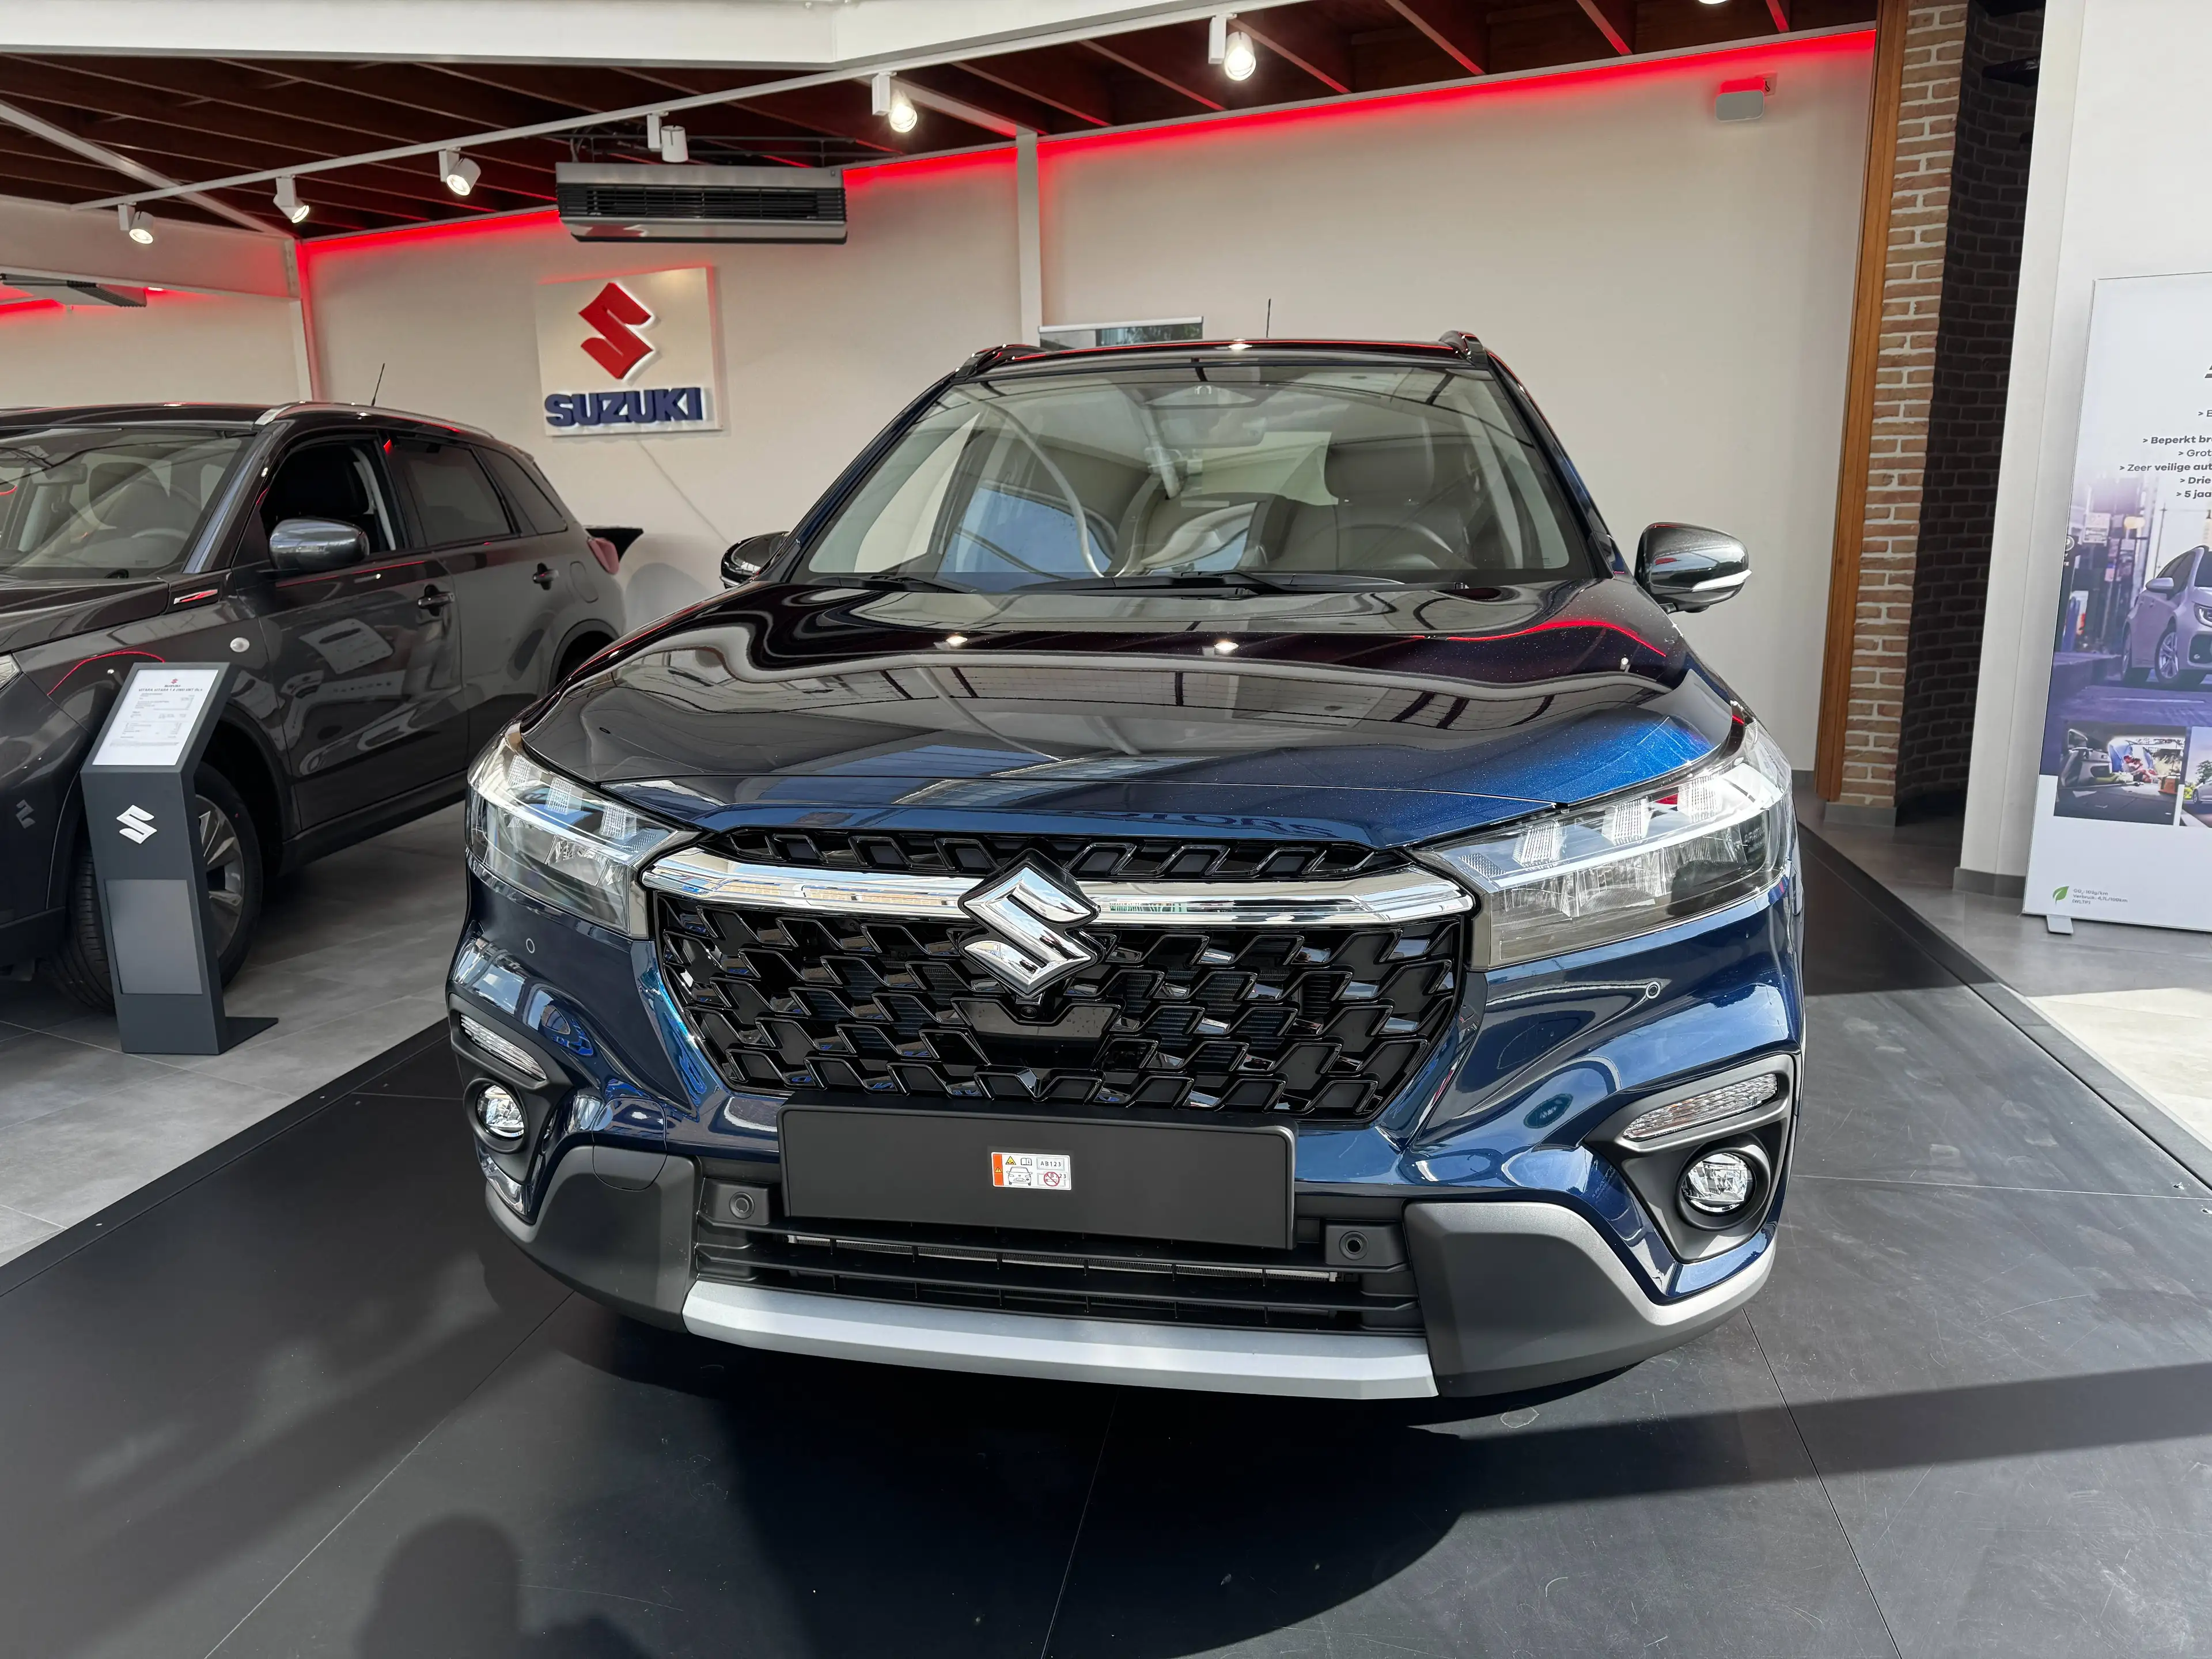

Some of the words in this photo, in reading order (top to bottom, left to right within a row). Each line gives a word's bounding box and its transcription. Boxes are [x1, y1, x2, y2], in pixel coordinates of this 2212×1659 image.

[545, 388, 703, 427] SUZUKI
[2151, 435, 2196, 445] Beperkt
[2199, 435, 2212, 443] br
[2187, 449, 2212, 457] Grot
[2154, 463, 2191, 472] veilige
[2188, 476, 2211, 484] Drie
[2184, 490, 2191, 498] 5
